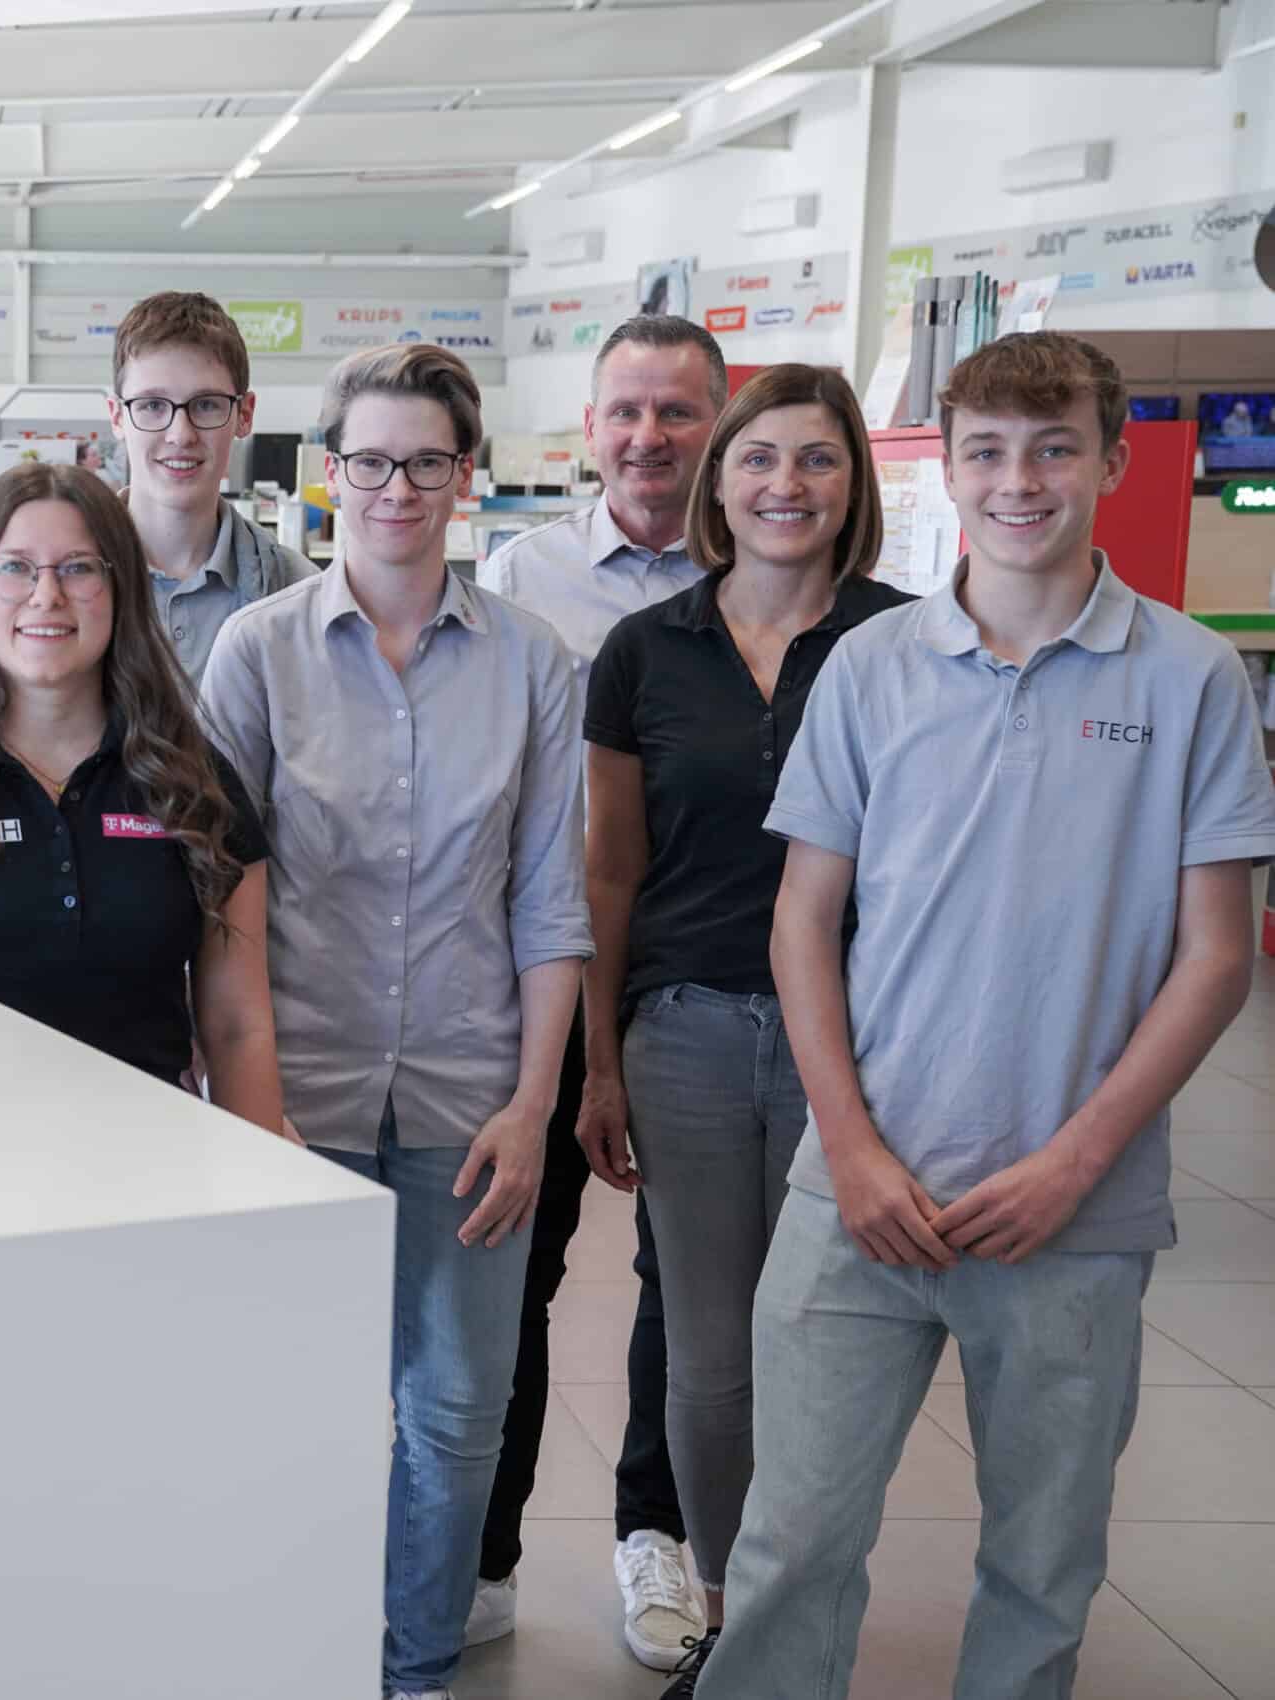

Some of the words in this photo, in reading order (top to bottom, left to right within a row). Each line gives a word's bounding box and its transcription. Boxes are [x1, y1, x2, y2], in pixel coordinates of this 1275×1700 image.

[1104, 223, 1172, 245] DURACELL
[1141, 261, 1195, 281] VARTA
[337, 309, 402, 323] KRUPS
[433, 335, 494, 347] TEFAL
[1082, 719, 1154, 744] ETECH
